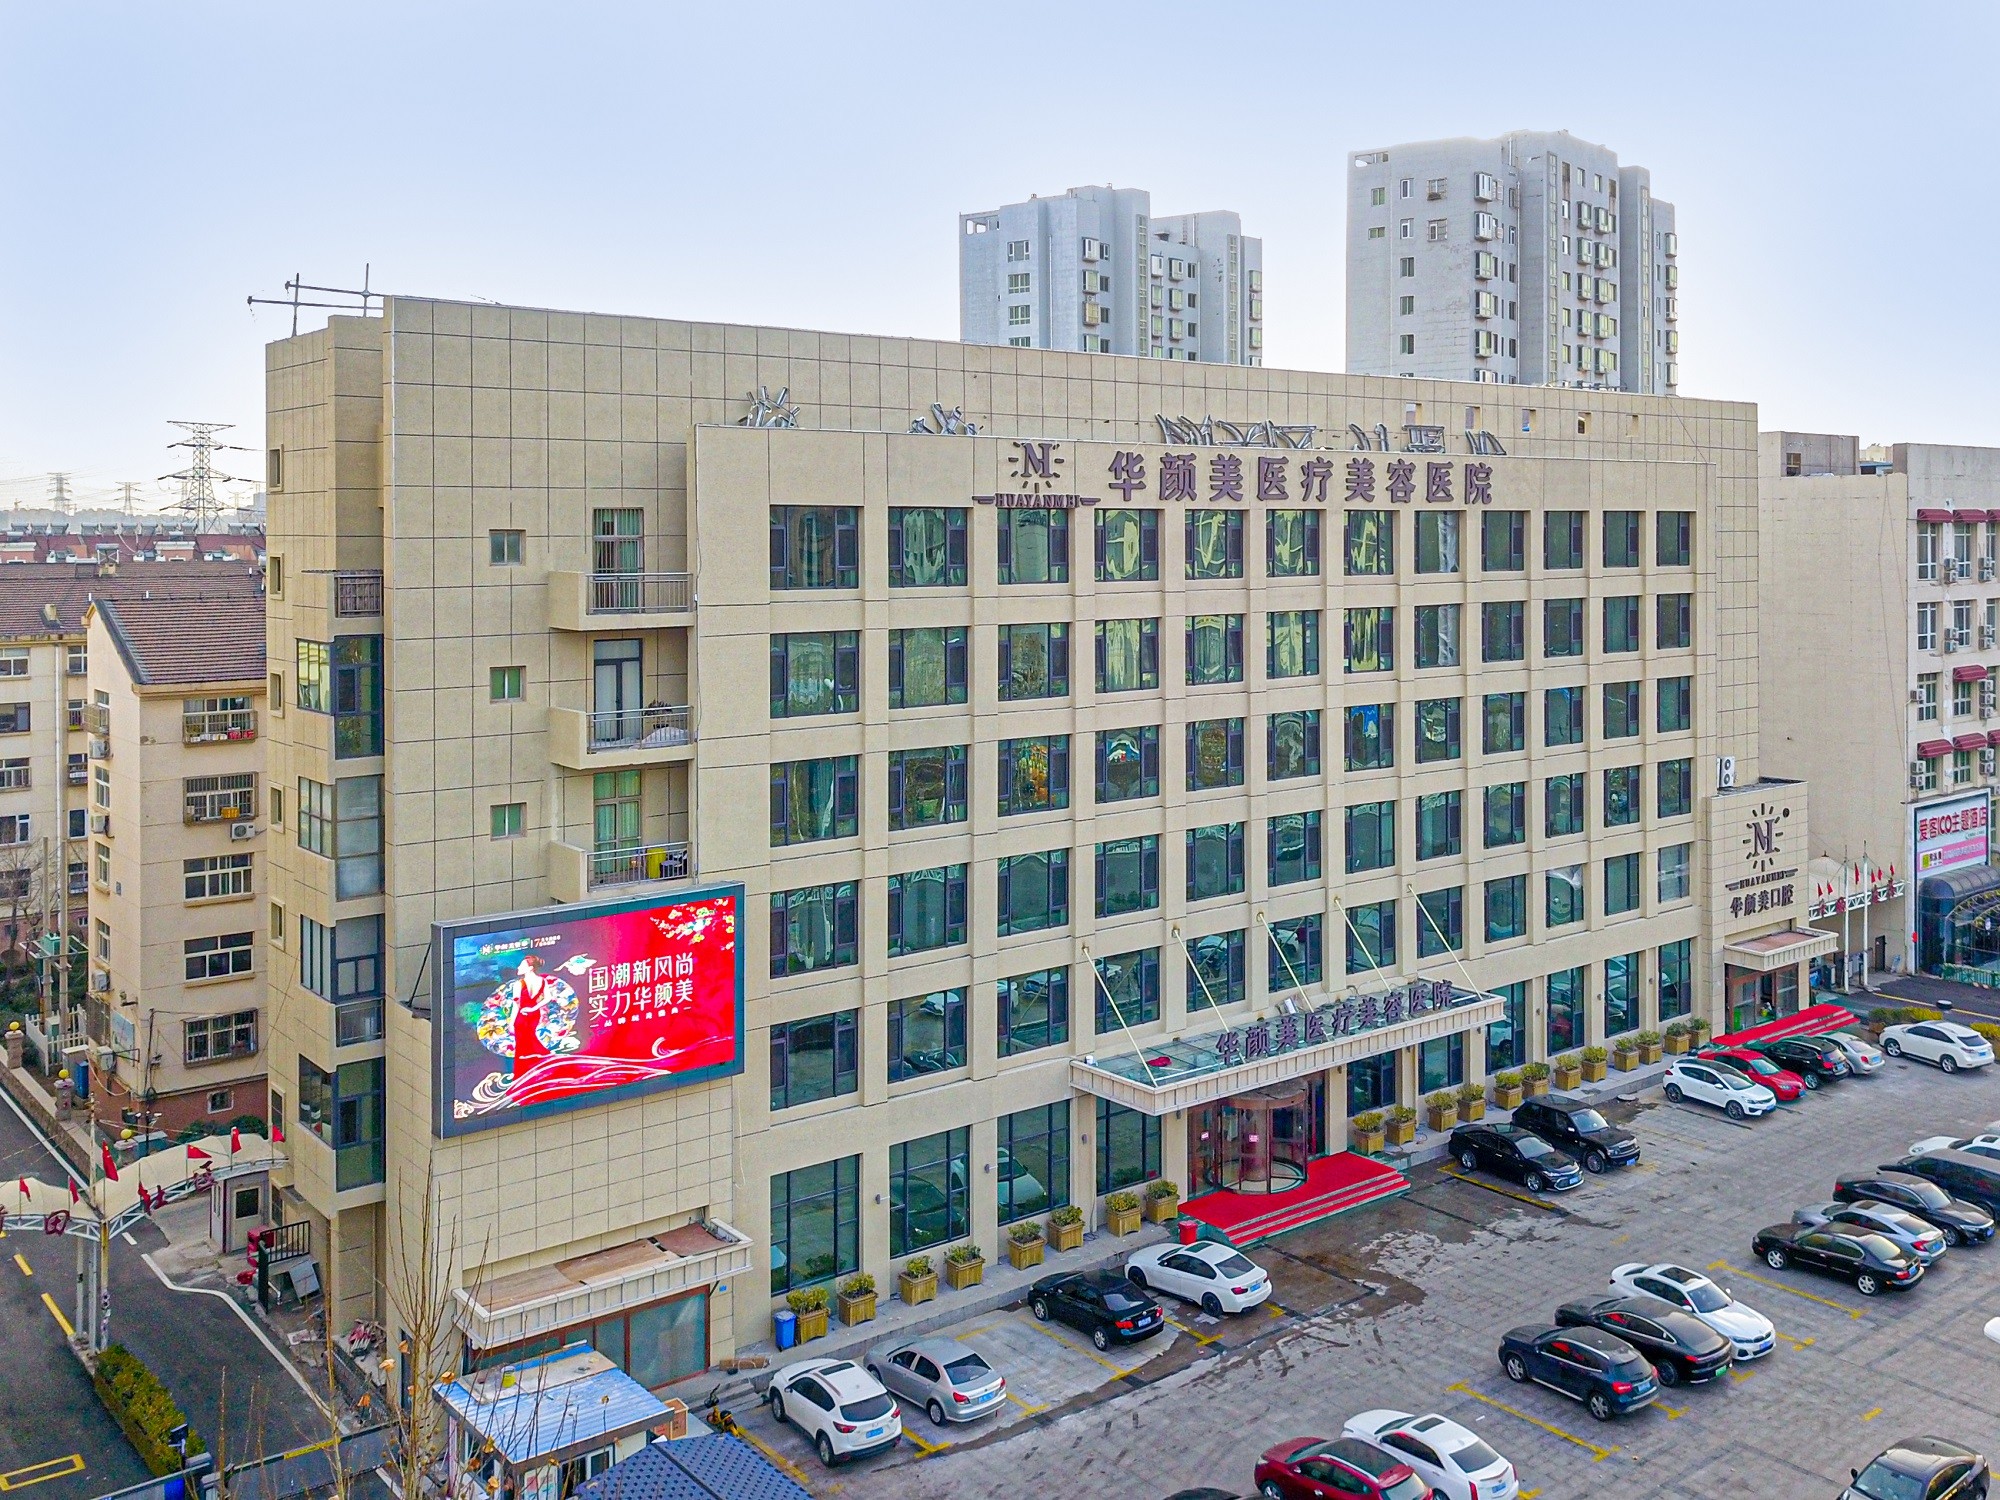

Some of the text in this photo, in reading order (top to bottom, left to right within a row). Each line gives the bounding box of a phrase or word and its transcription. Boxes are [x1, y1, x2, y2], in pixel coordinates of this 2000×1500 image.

[1108, 450, 1494, 504] 华颜美医疗美容医院
[994, 493, 1080, 508] HUAYANMEI
[1729, 883, 1794, 919] 华颜美口腔
[588, 952, 694, 993] 国潮新风尚
[588, 978, 694, 1021] 实力华颜美
[1215, 979, 1453, 1066] 华颜美医疗美容医院
